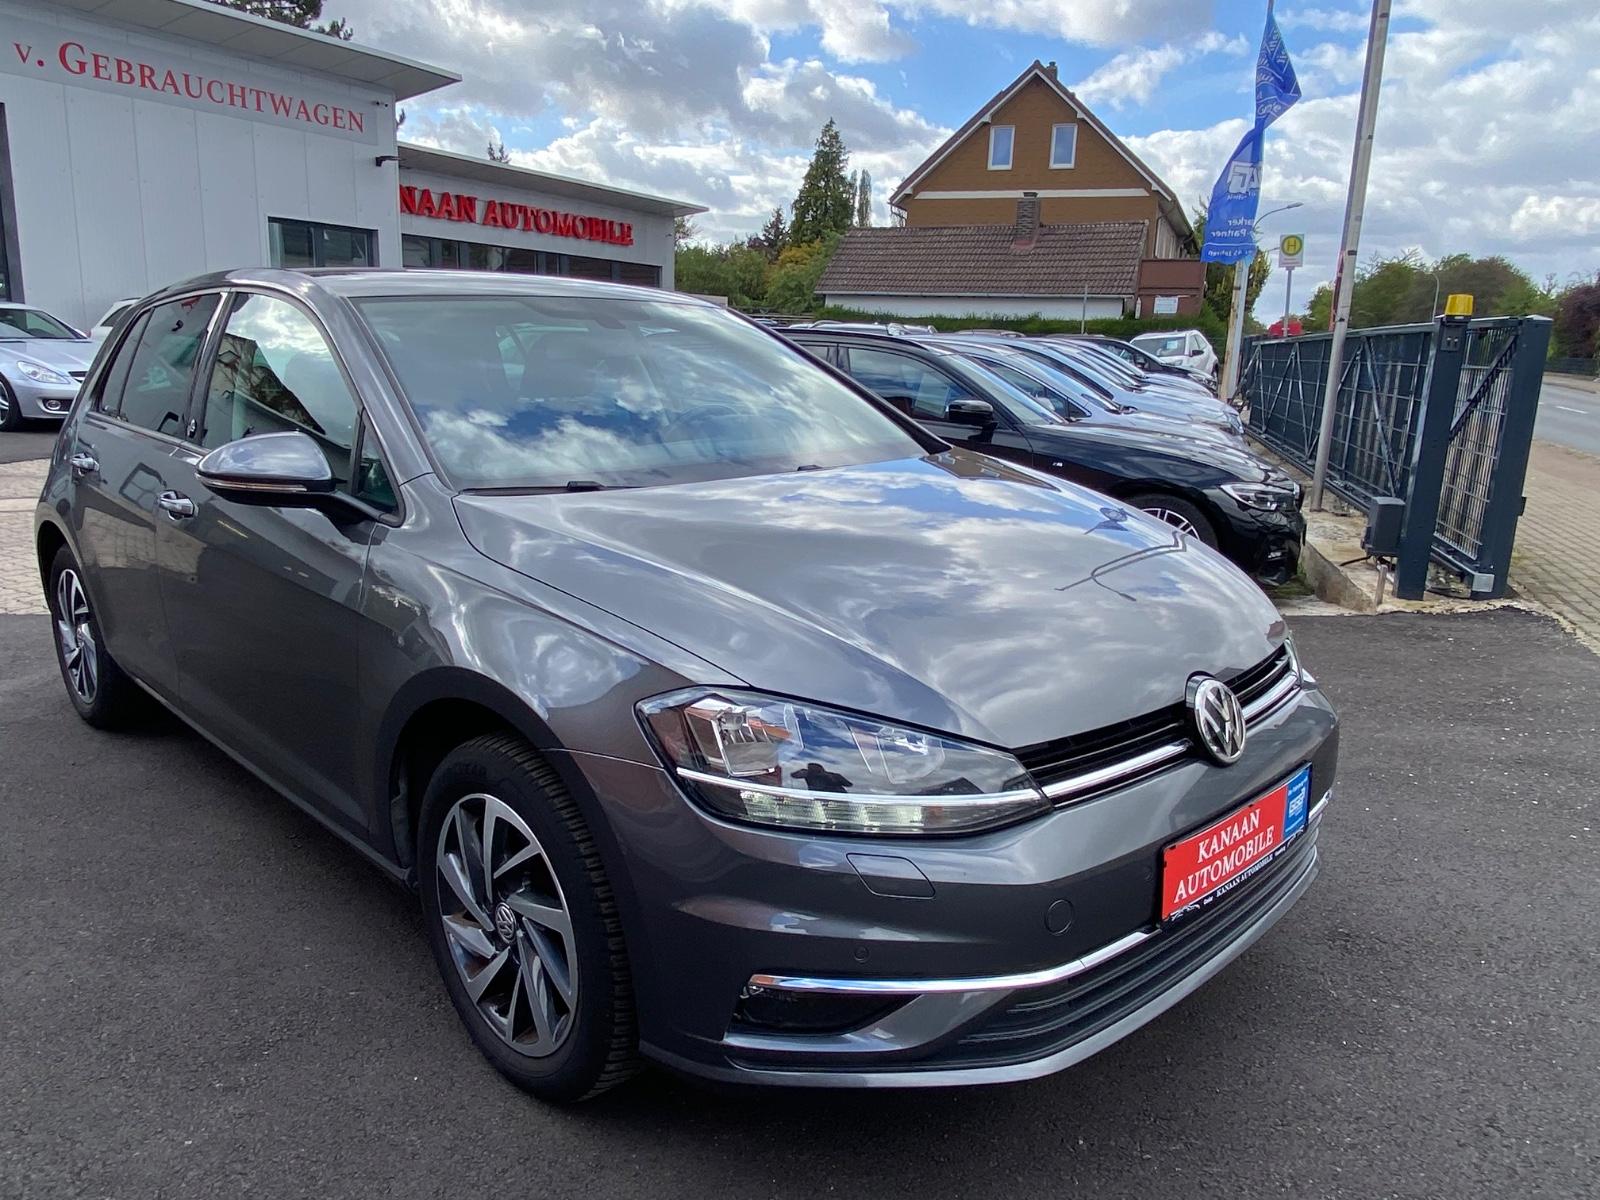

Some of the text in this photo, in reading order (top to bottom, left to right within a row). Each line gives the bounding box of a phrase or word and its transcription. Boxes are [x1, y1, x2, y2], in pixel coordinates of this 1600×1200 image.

[58, 41, 365, 133] GEBRAUCHTWAGEN
[482, 200, 634, 246] AUTOMOBILE
[1287, 239, 1297, 252] H
[1197, 808, 1261, 863] KANAAN
[1173, 825, 1275, 904] AUTOMOBILE
